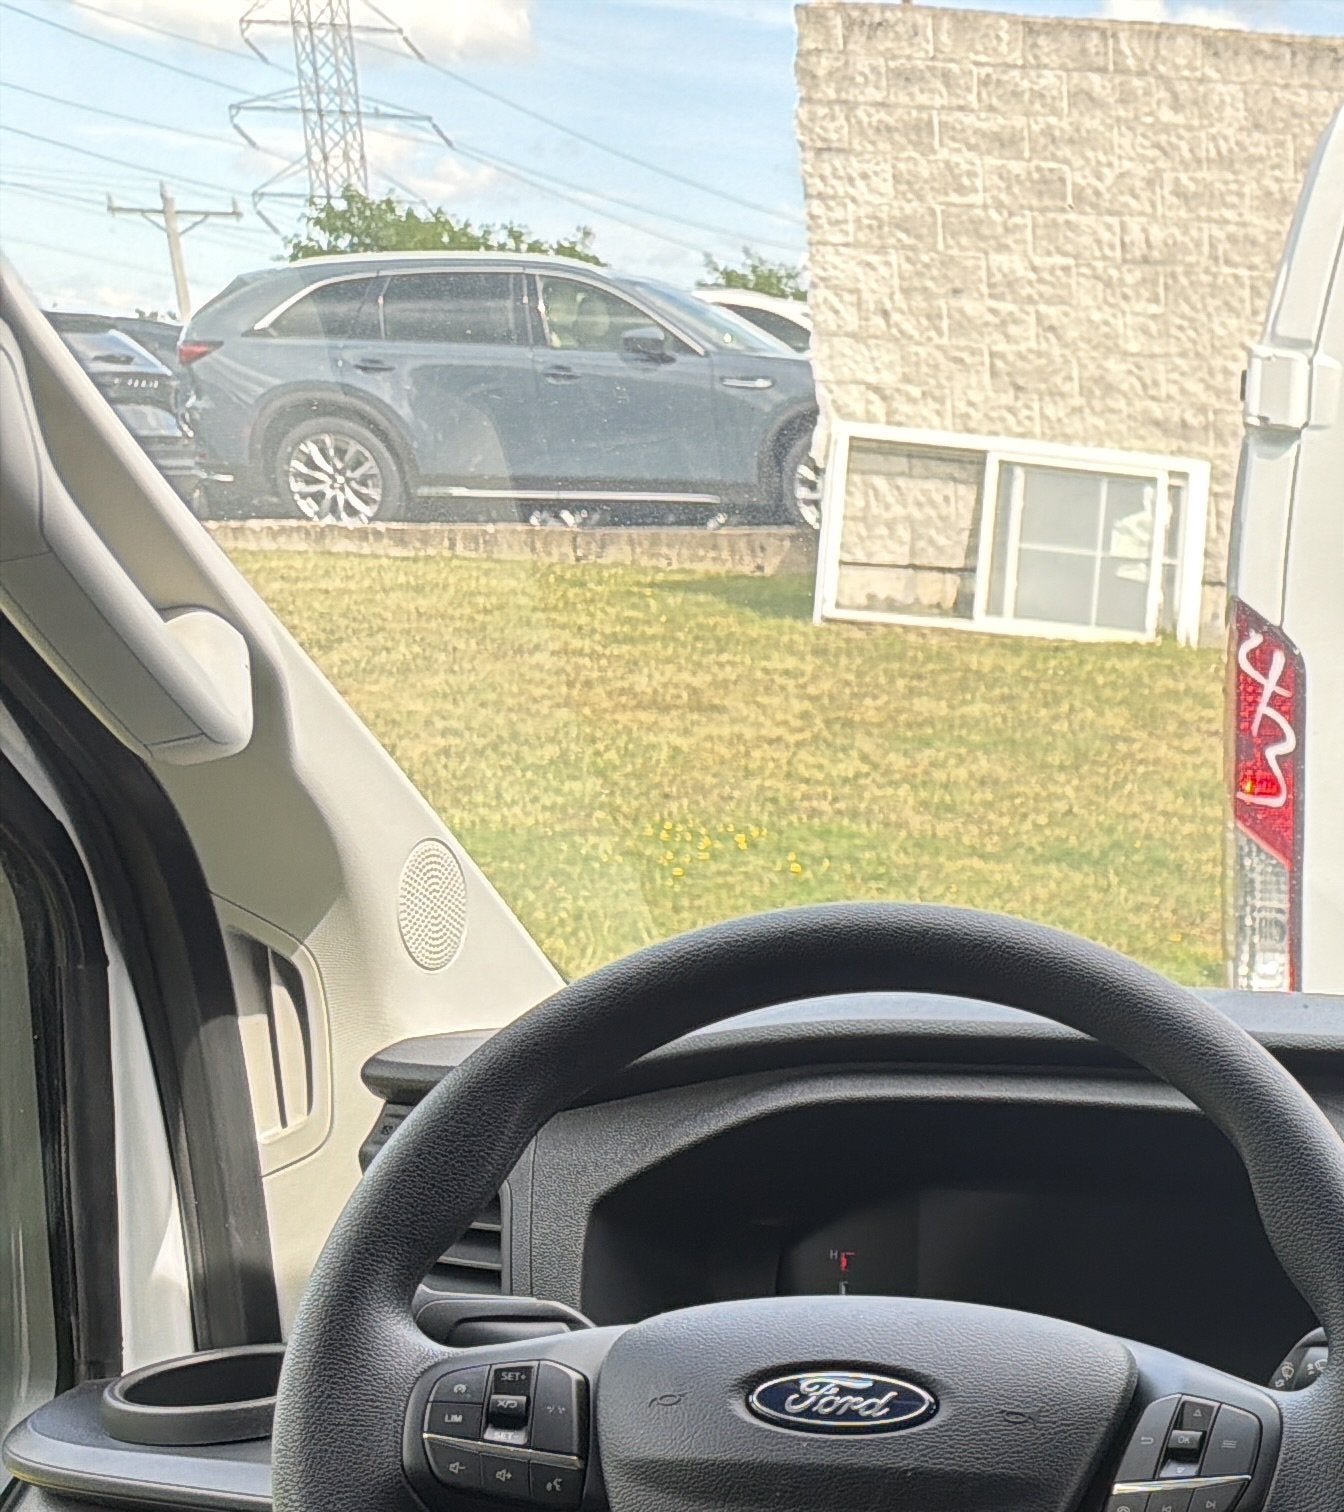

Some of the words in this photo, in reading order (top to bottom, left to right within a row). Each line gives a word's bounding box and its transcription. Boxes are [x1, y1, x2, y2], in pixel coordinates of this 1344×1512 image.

[829, 1248, 839, 1261] H
[784, 1377, 898, 1418] Ford
[444, 1413, 463, 1423] LIM
[1177, 1436, 1191, 1445] OK
